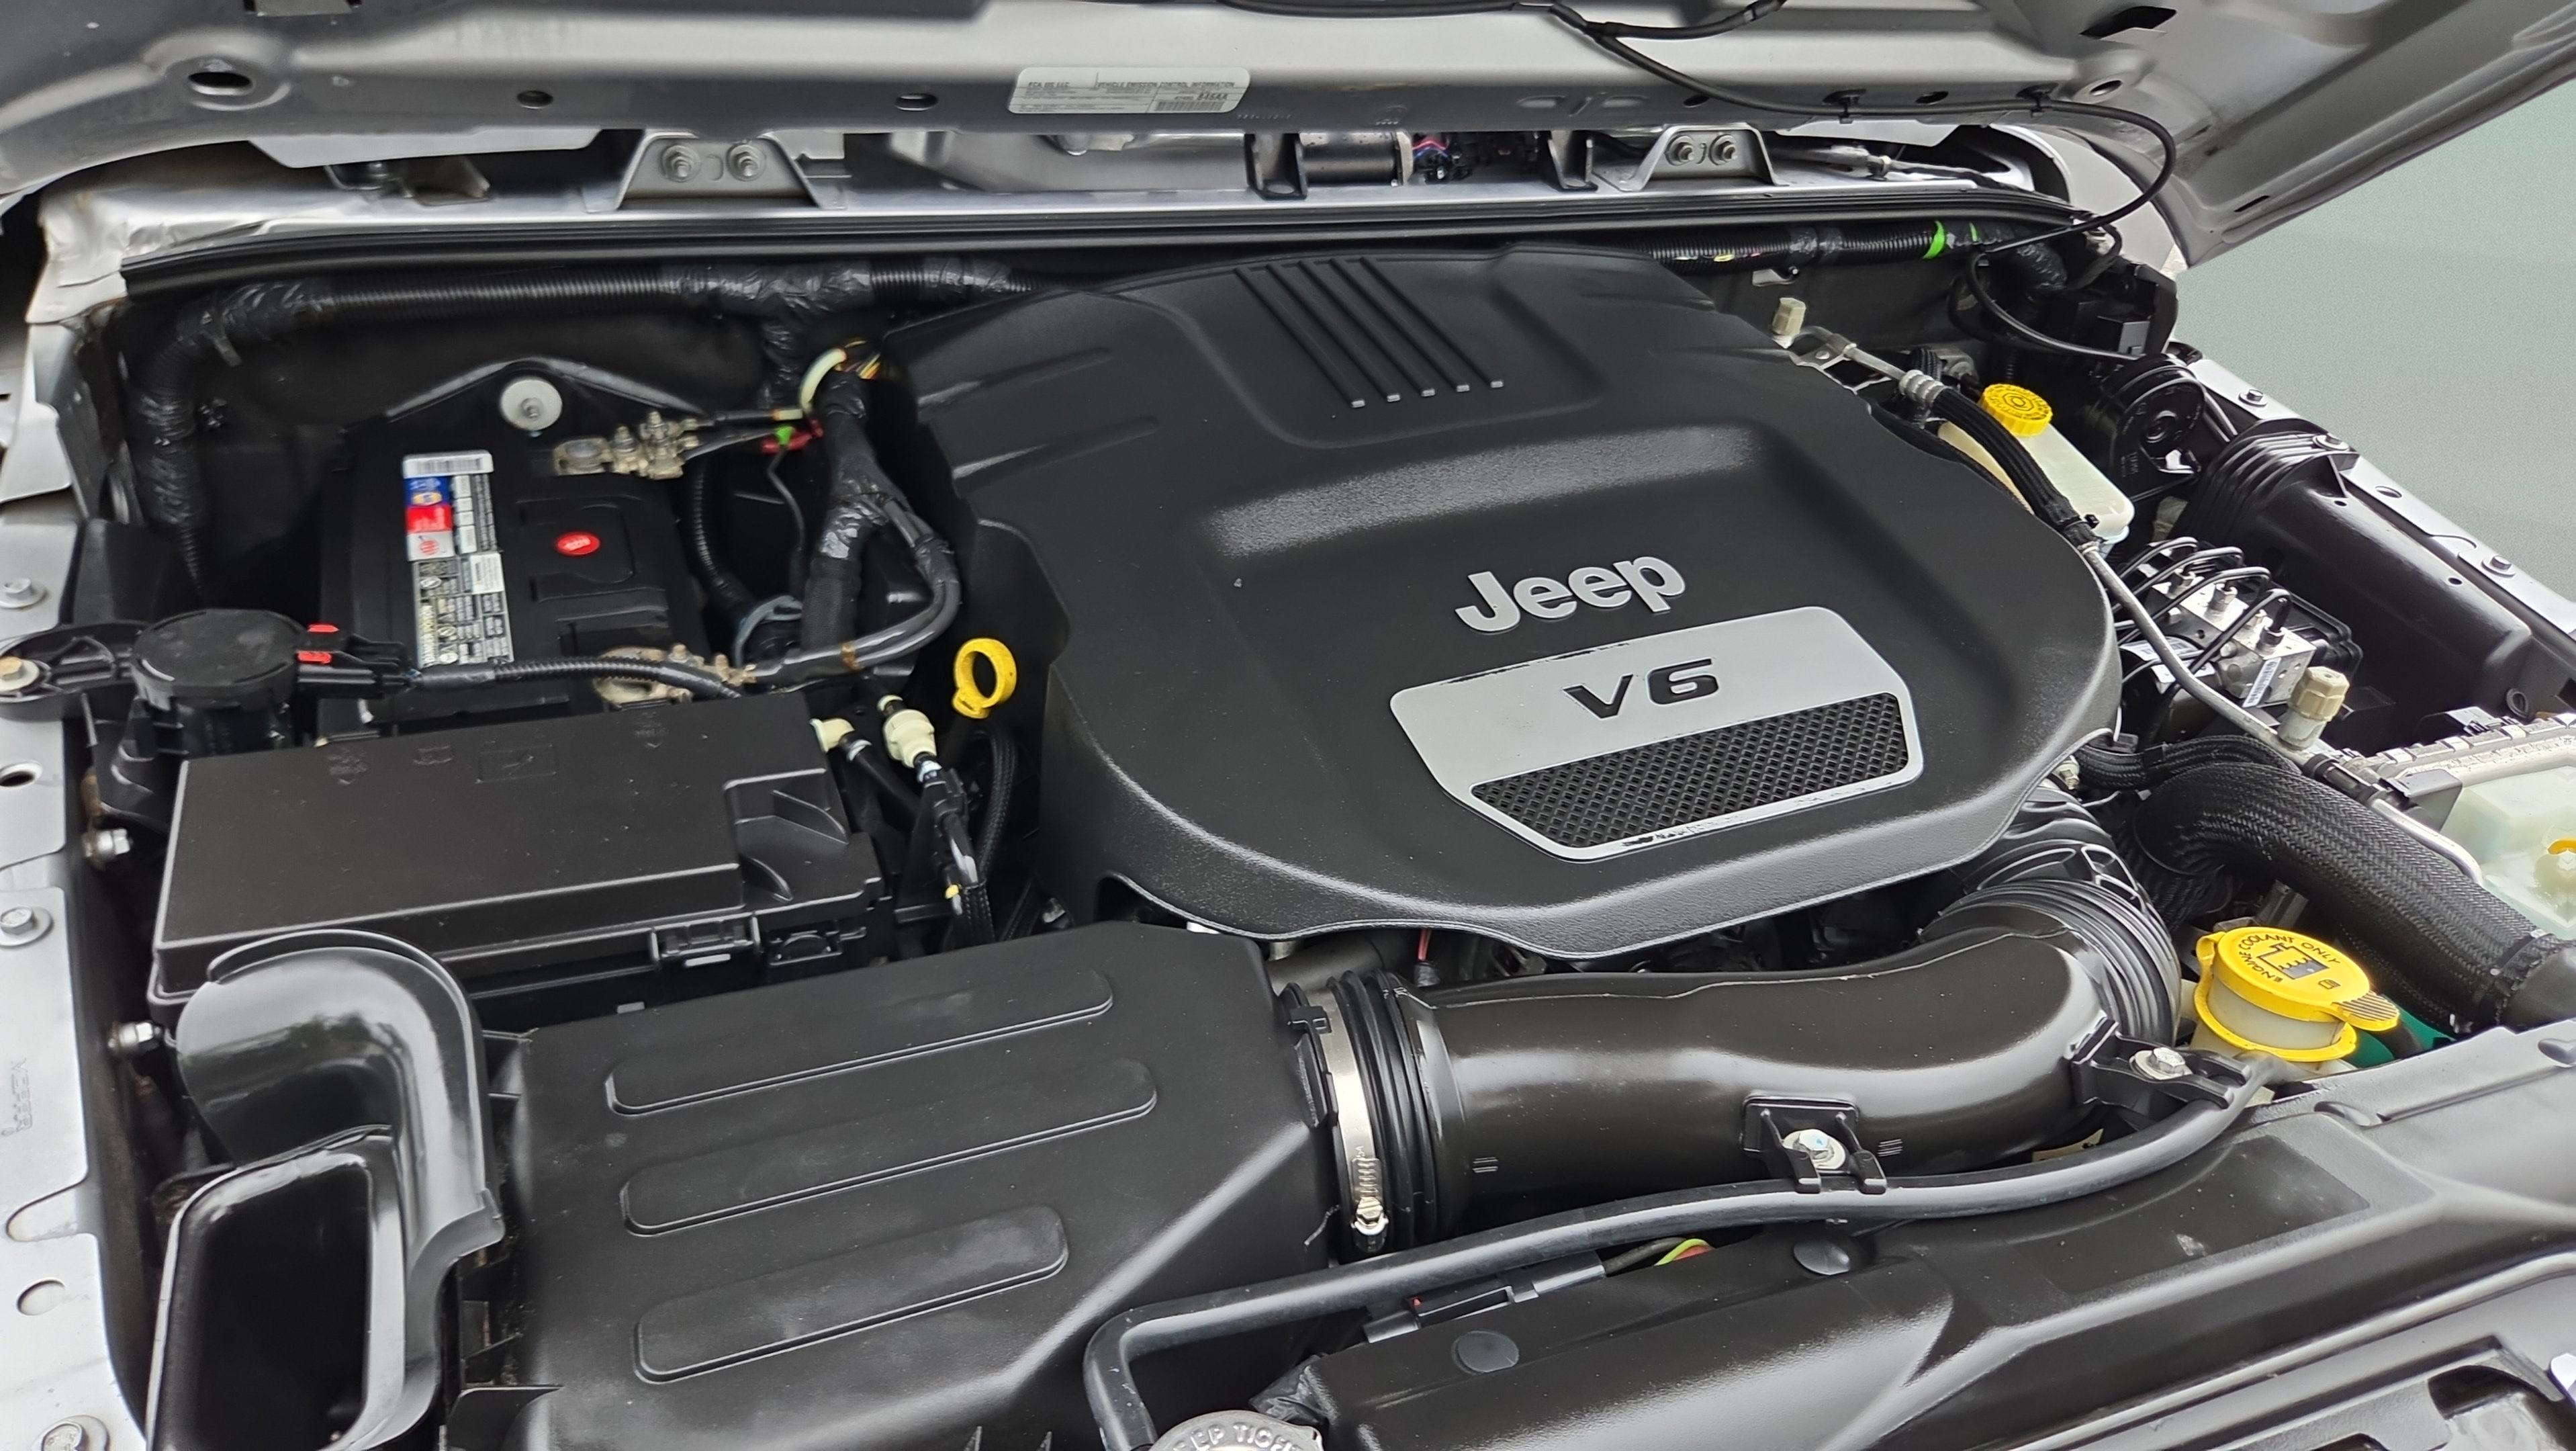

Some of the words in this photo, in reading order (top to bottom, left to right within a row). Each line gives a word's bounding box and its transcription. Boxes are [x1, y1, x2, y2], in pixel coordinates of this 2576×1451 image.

[1455, 556, 1686, 631] Jeep
[1561, 658, 1719, 719] V6
[2238, 934, 2295, 951] COOLANT
[2300, 942, 2342, 965] ONLY
[2238, 950, 2284, 983] ENGINE
